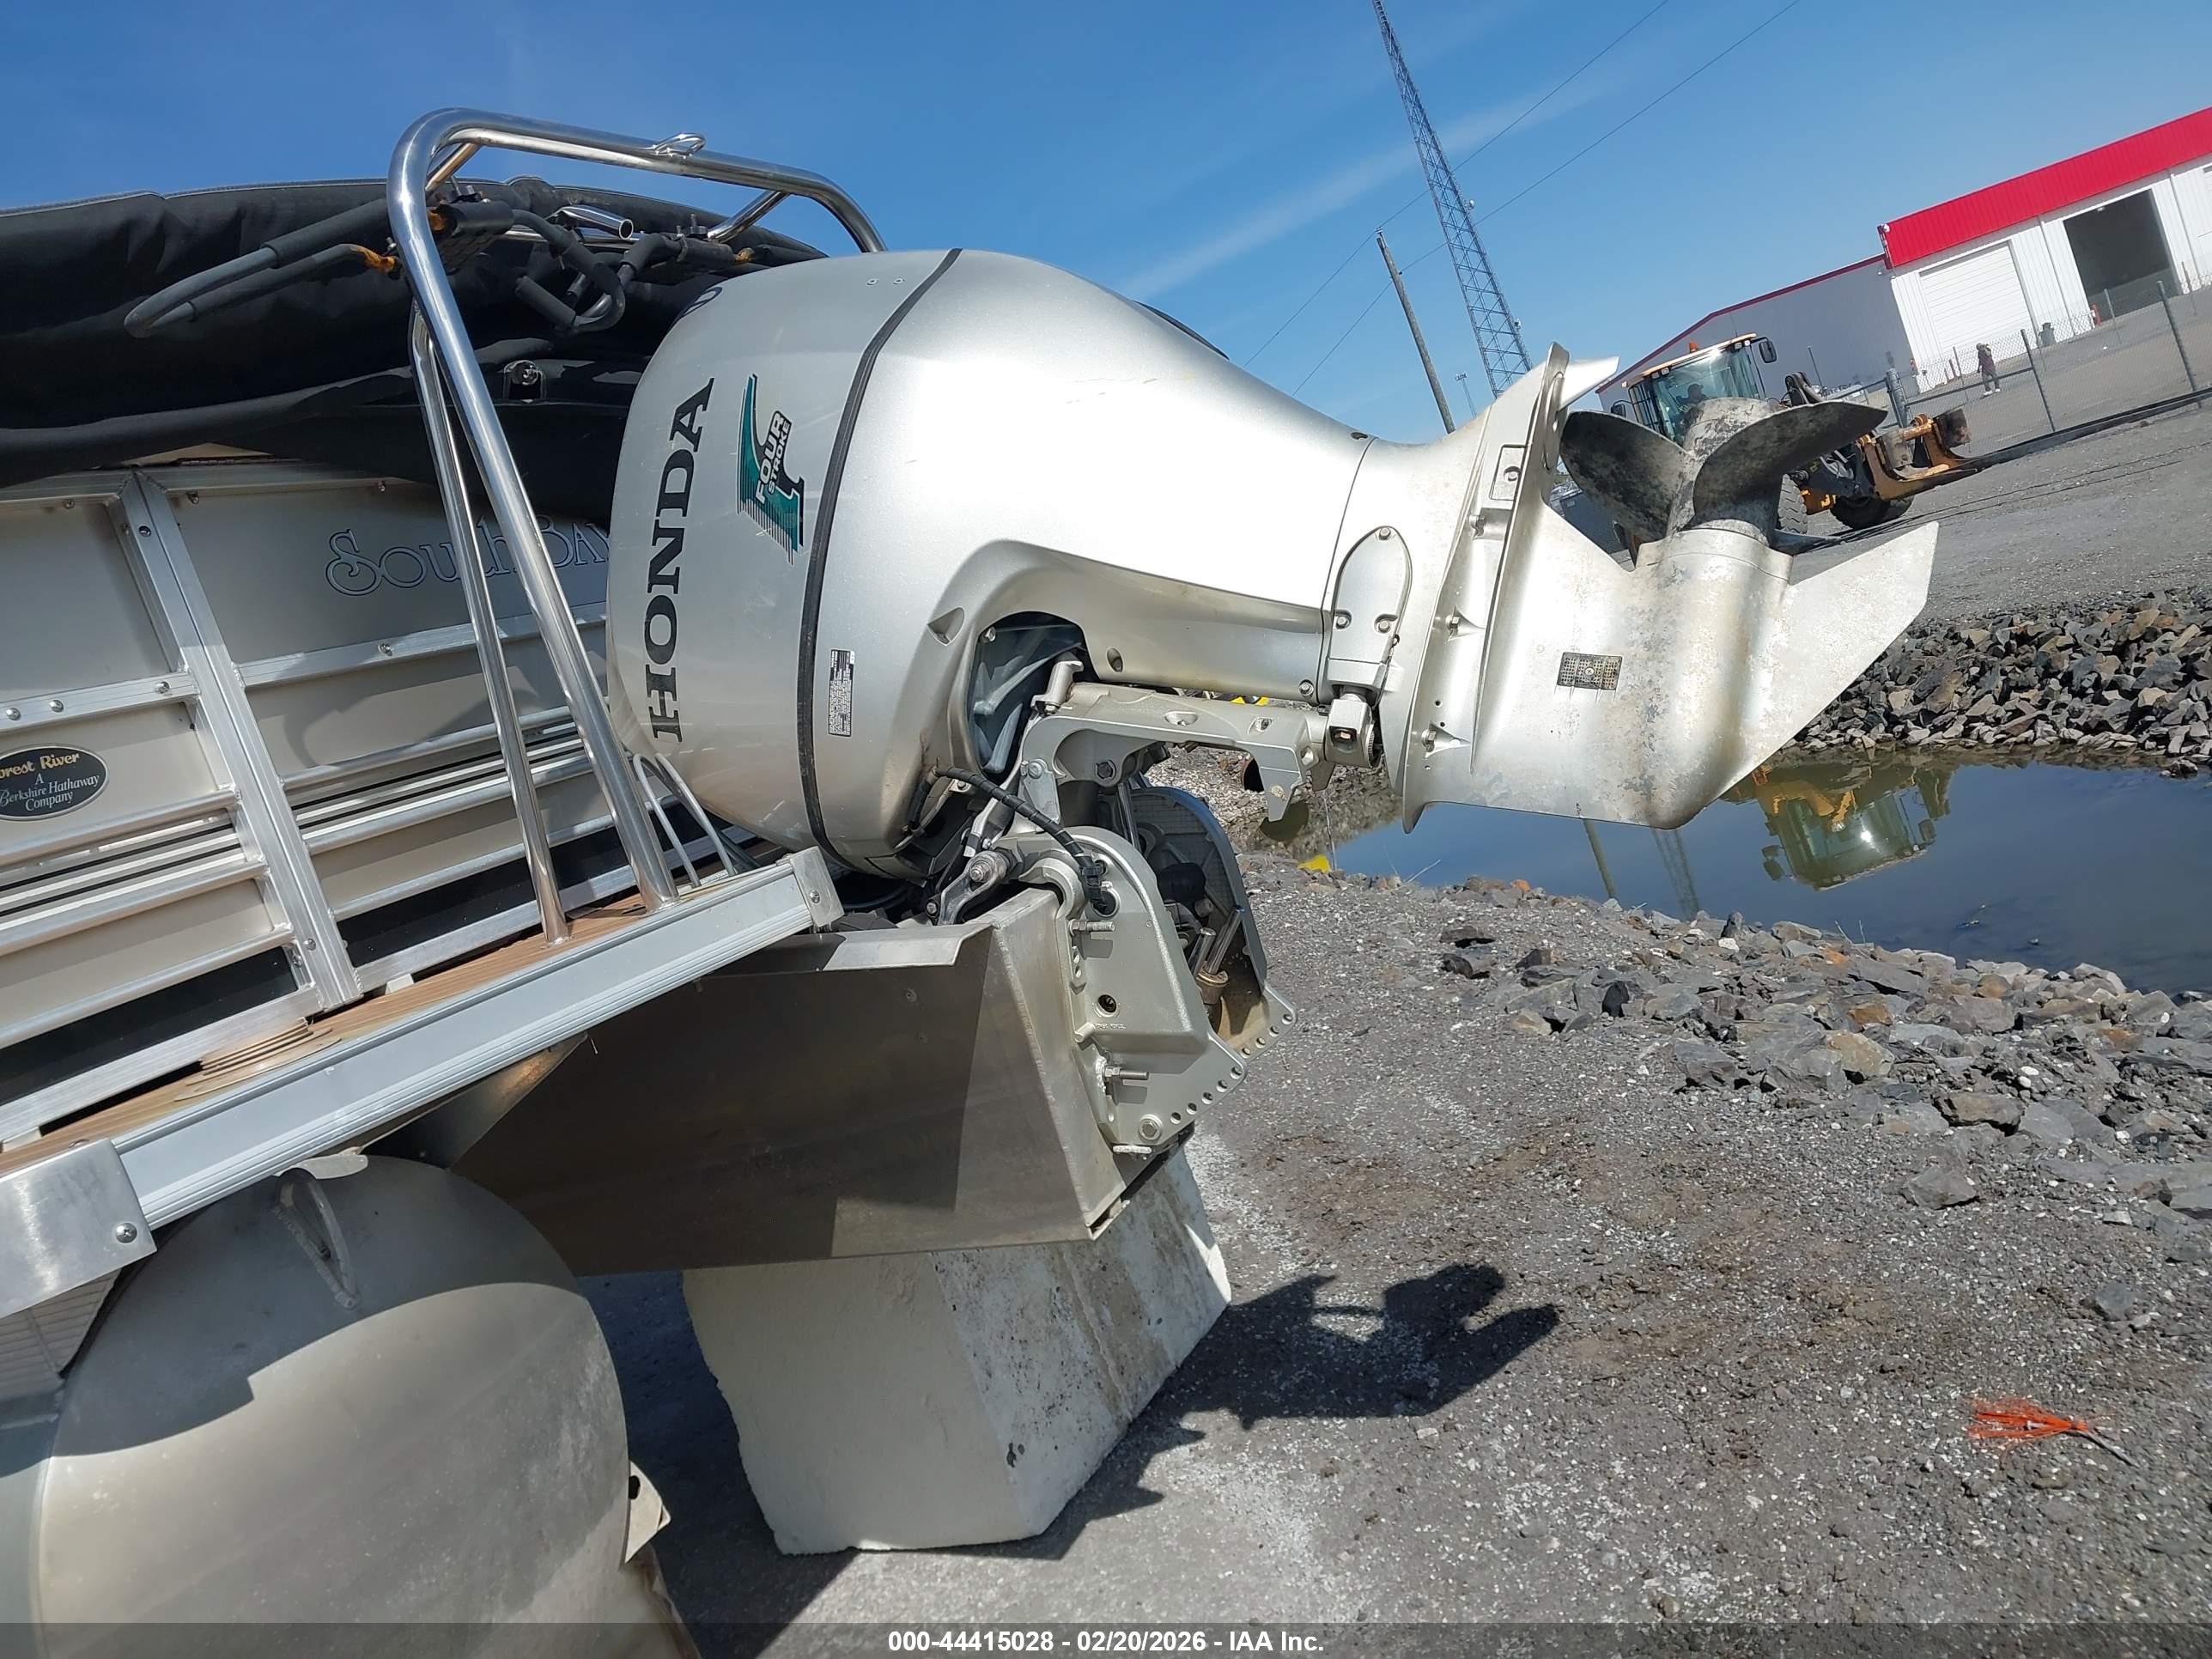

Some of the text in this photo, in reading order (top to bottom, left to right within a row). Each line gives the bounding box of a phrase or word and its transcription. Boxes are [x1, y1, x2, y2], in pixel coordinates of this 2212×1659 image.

[756, 412, 784, 504] FOUR
[768, 419, 790, 495] STROKE
[325, 515, 510, 596] Souh
[644, 377, 715, 743] HONDA
[0, 752, 81, 779] orest River
[0, 775, 100, 807] Berkshire Hathaway
[35, 773, 45, 785] A
[25, 791, 74, 811] Company
